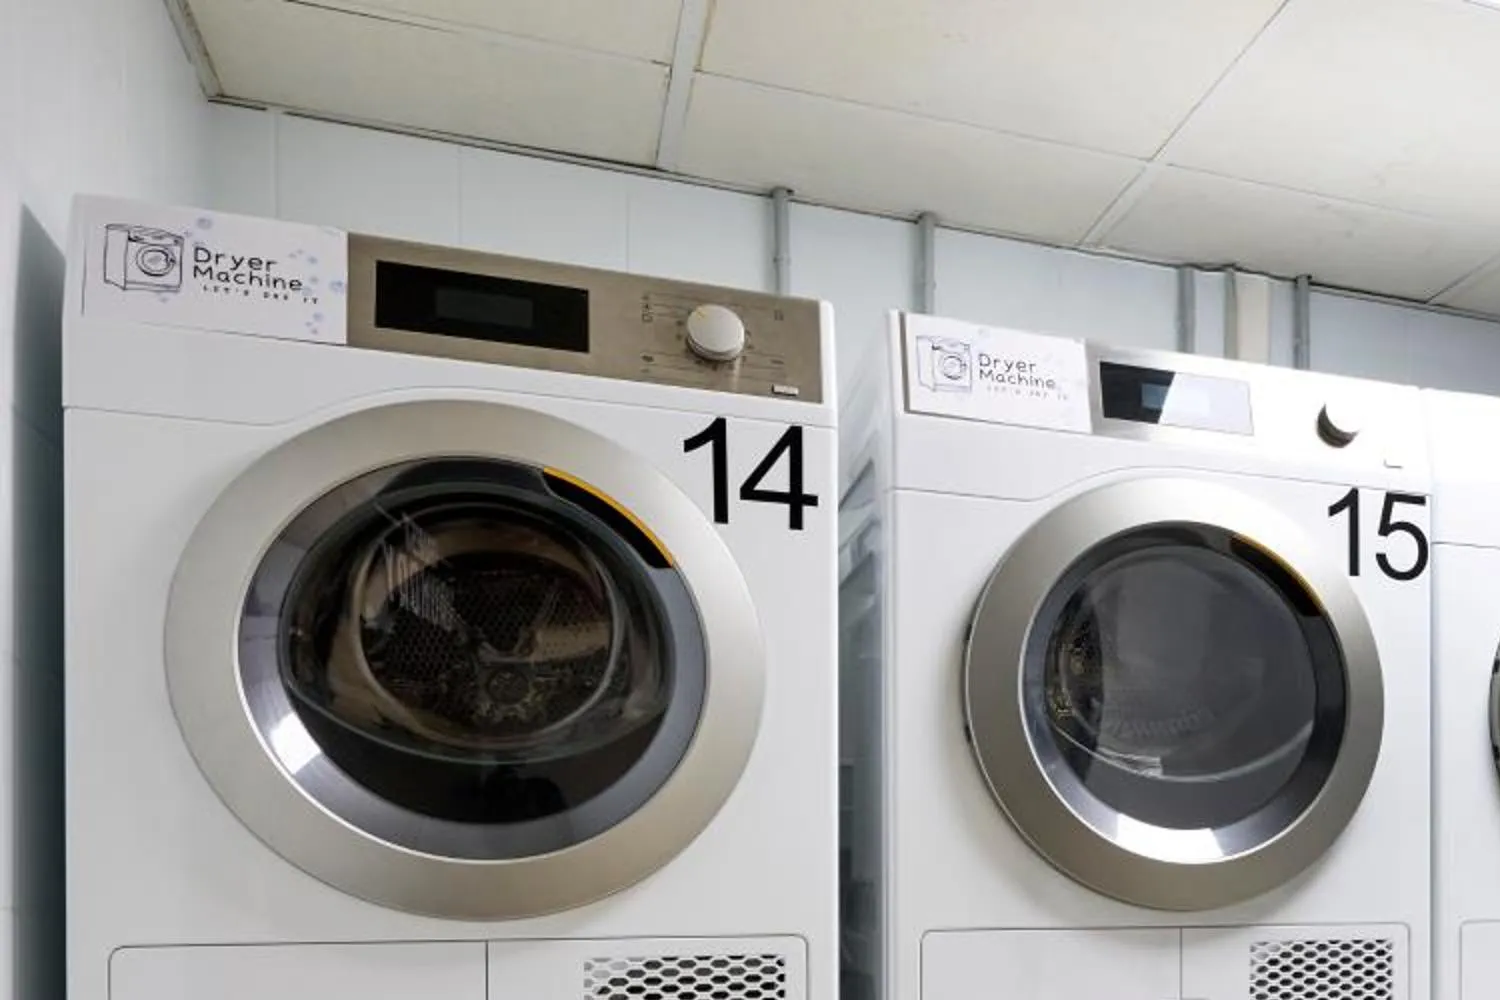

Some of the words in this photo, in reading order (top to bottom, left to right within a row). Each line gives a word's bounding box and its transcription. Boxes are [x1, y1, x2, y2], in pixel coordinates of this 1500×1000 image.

[194, 246, 277, 271] Dryer
[193, 265, 303, 291] Machine
[978, 353, 1037, 374] Dryer
[979, 369, 1057, 390] Machine
[684, 417, 819, 531] 14
[1327, 486, 1429, 581] 15
